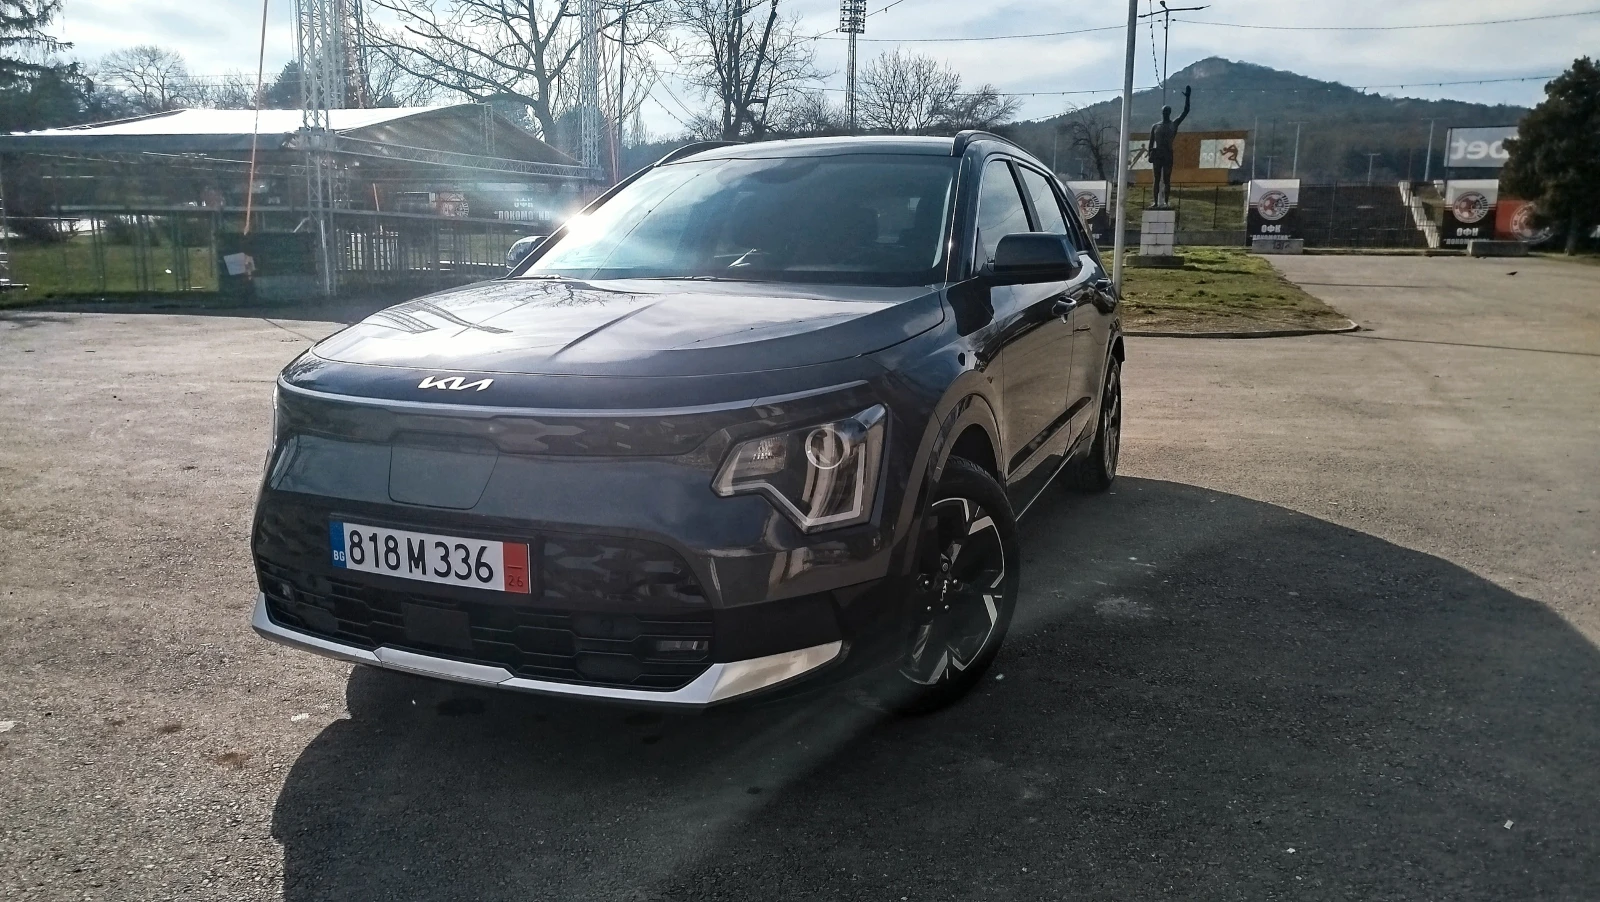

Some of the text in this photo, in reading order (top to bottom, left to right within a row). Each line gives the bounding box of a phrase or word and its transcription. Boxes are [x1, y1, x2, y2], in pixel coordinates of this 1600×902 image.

[1261, 224, 1281, 233] ОФК
[1456, 227, 1479, 237] ОФК
[417, 375, 494, 392] KIA
[333, 549, 346, 563] BG
[508, 574, 524, 588] 26
